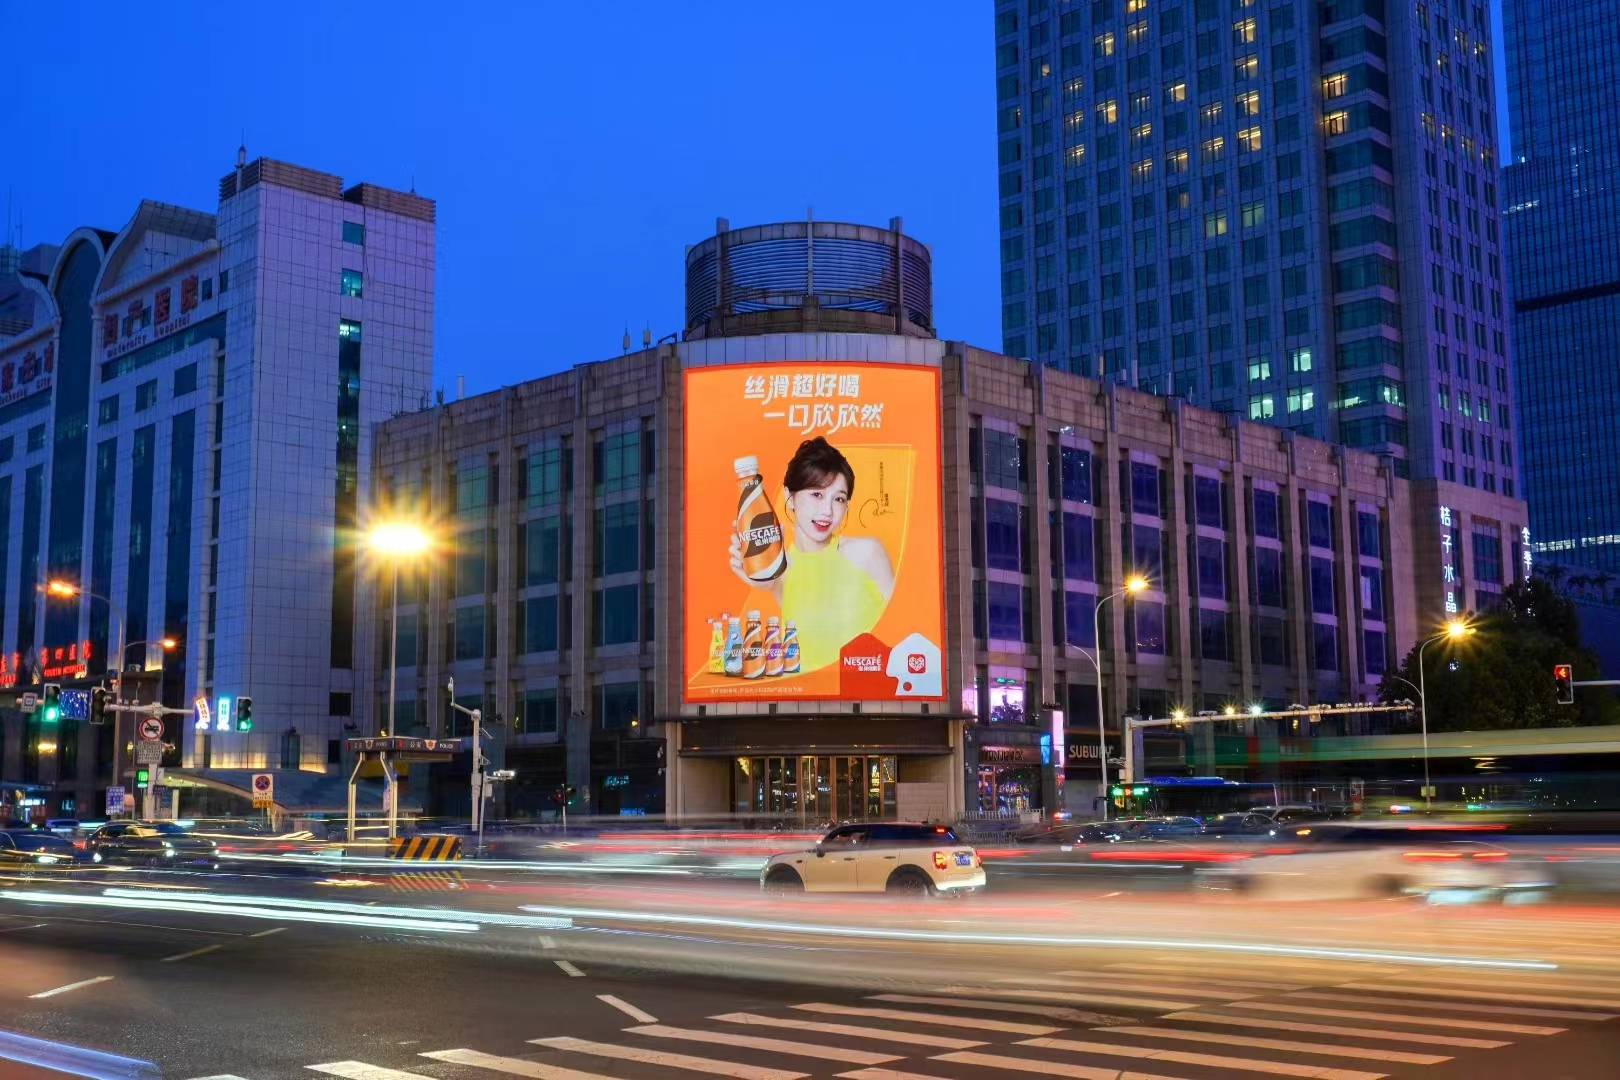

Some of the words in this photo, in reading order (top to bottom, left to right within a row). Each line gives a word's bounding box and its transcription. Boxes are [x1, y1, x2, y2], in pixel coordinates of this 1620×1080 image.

[744, 373, 861, 406] 丝滑超好喝
[763, 402, 884, 436] 一口欣欣然
[1440, 505, 1457, 613] 桔子水晶
[843, 653, 882, 666] NESCAFÉ
